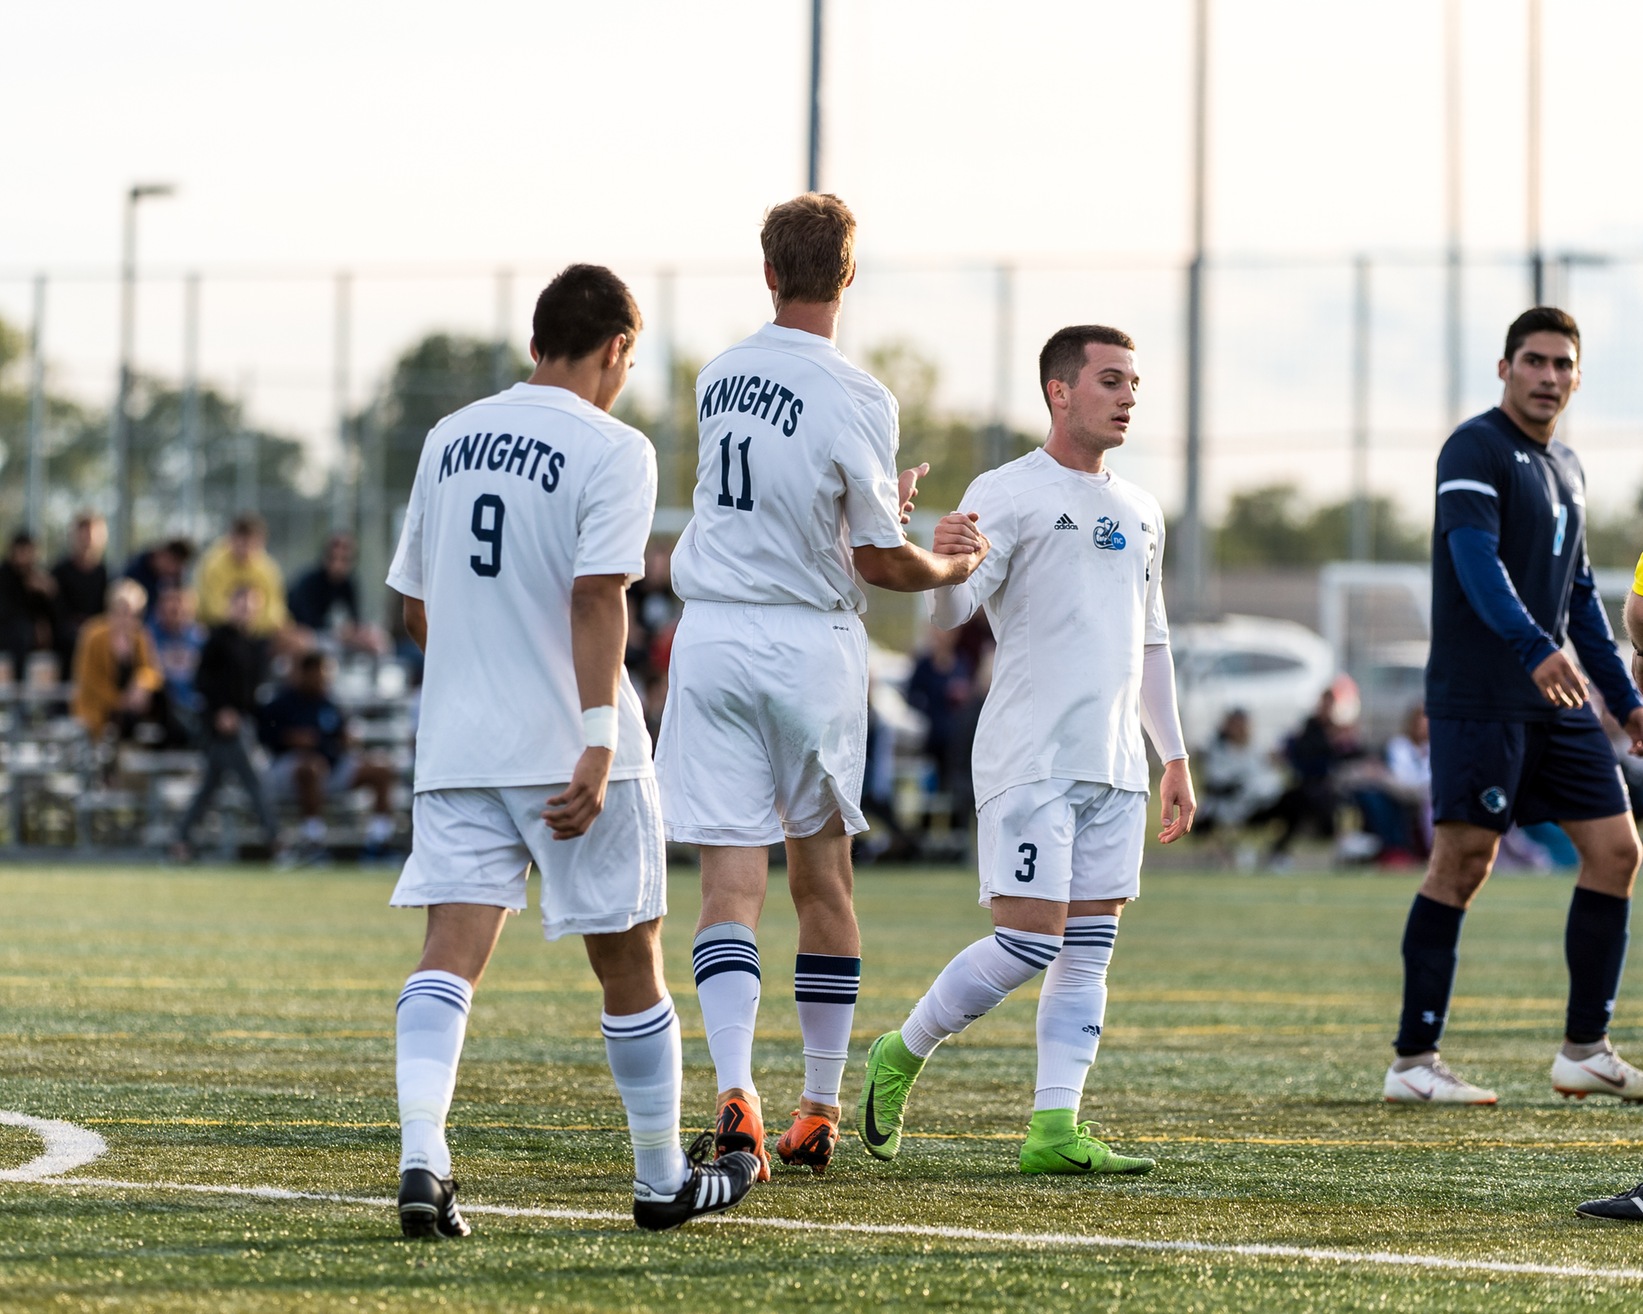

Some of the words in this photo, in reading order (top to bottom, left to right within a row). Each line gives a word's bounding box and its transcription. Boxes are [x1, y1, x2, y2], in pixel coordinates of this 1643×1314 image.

[700, 375, 803, 437] KNIGHTS
[438, 433, 565, 493] KNIGHTS
[718, 432, 754, 511] 11
[470, 493, 505, 578] 9
[1054, 522, 1078, 531] adidas
[1015, 842, 1038, 882] 3
